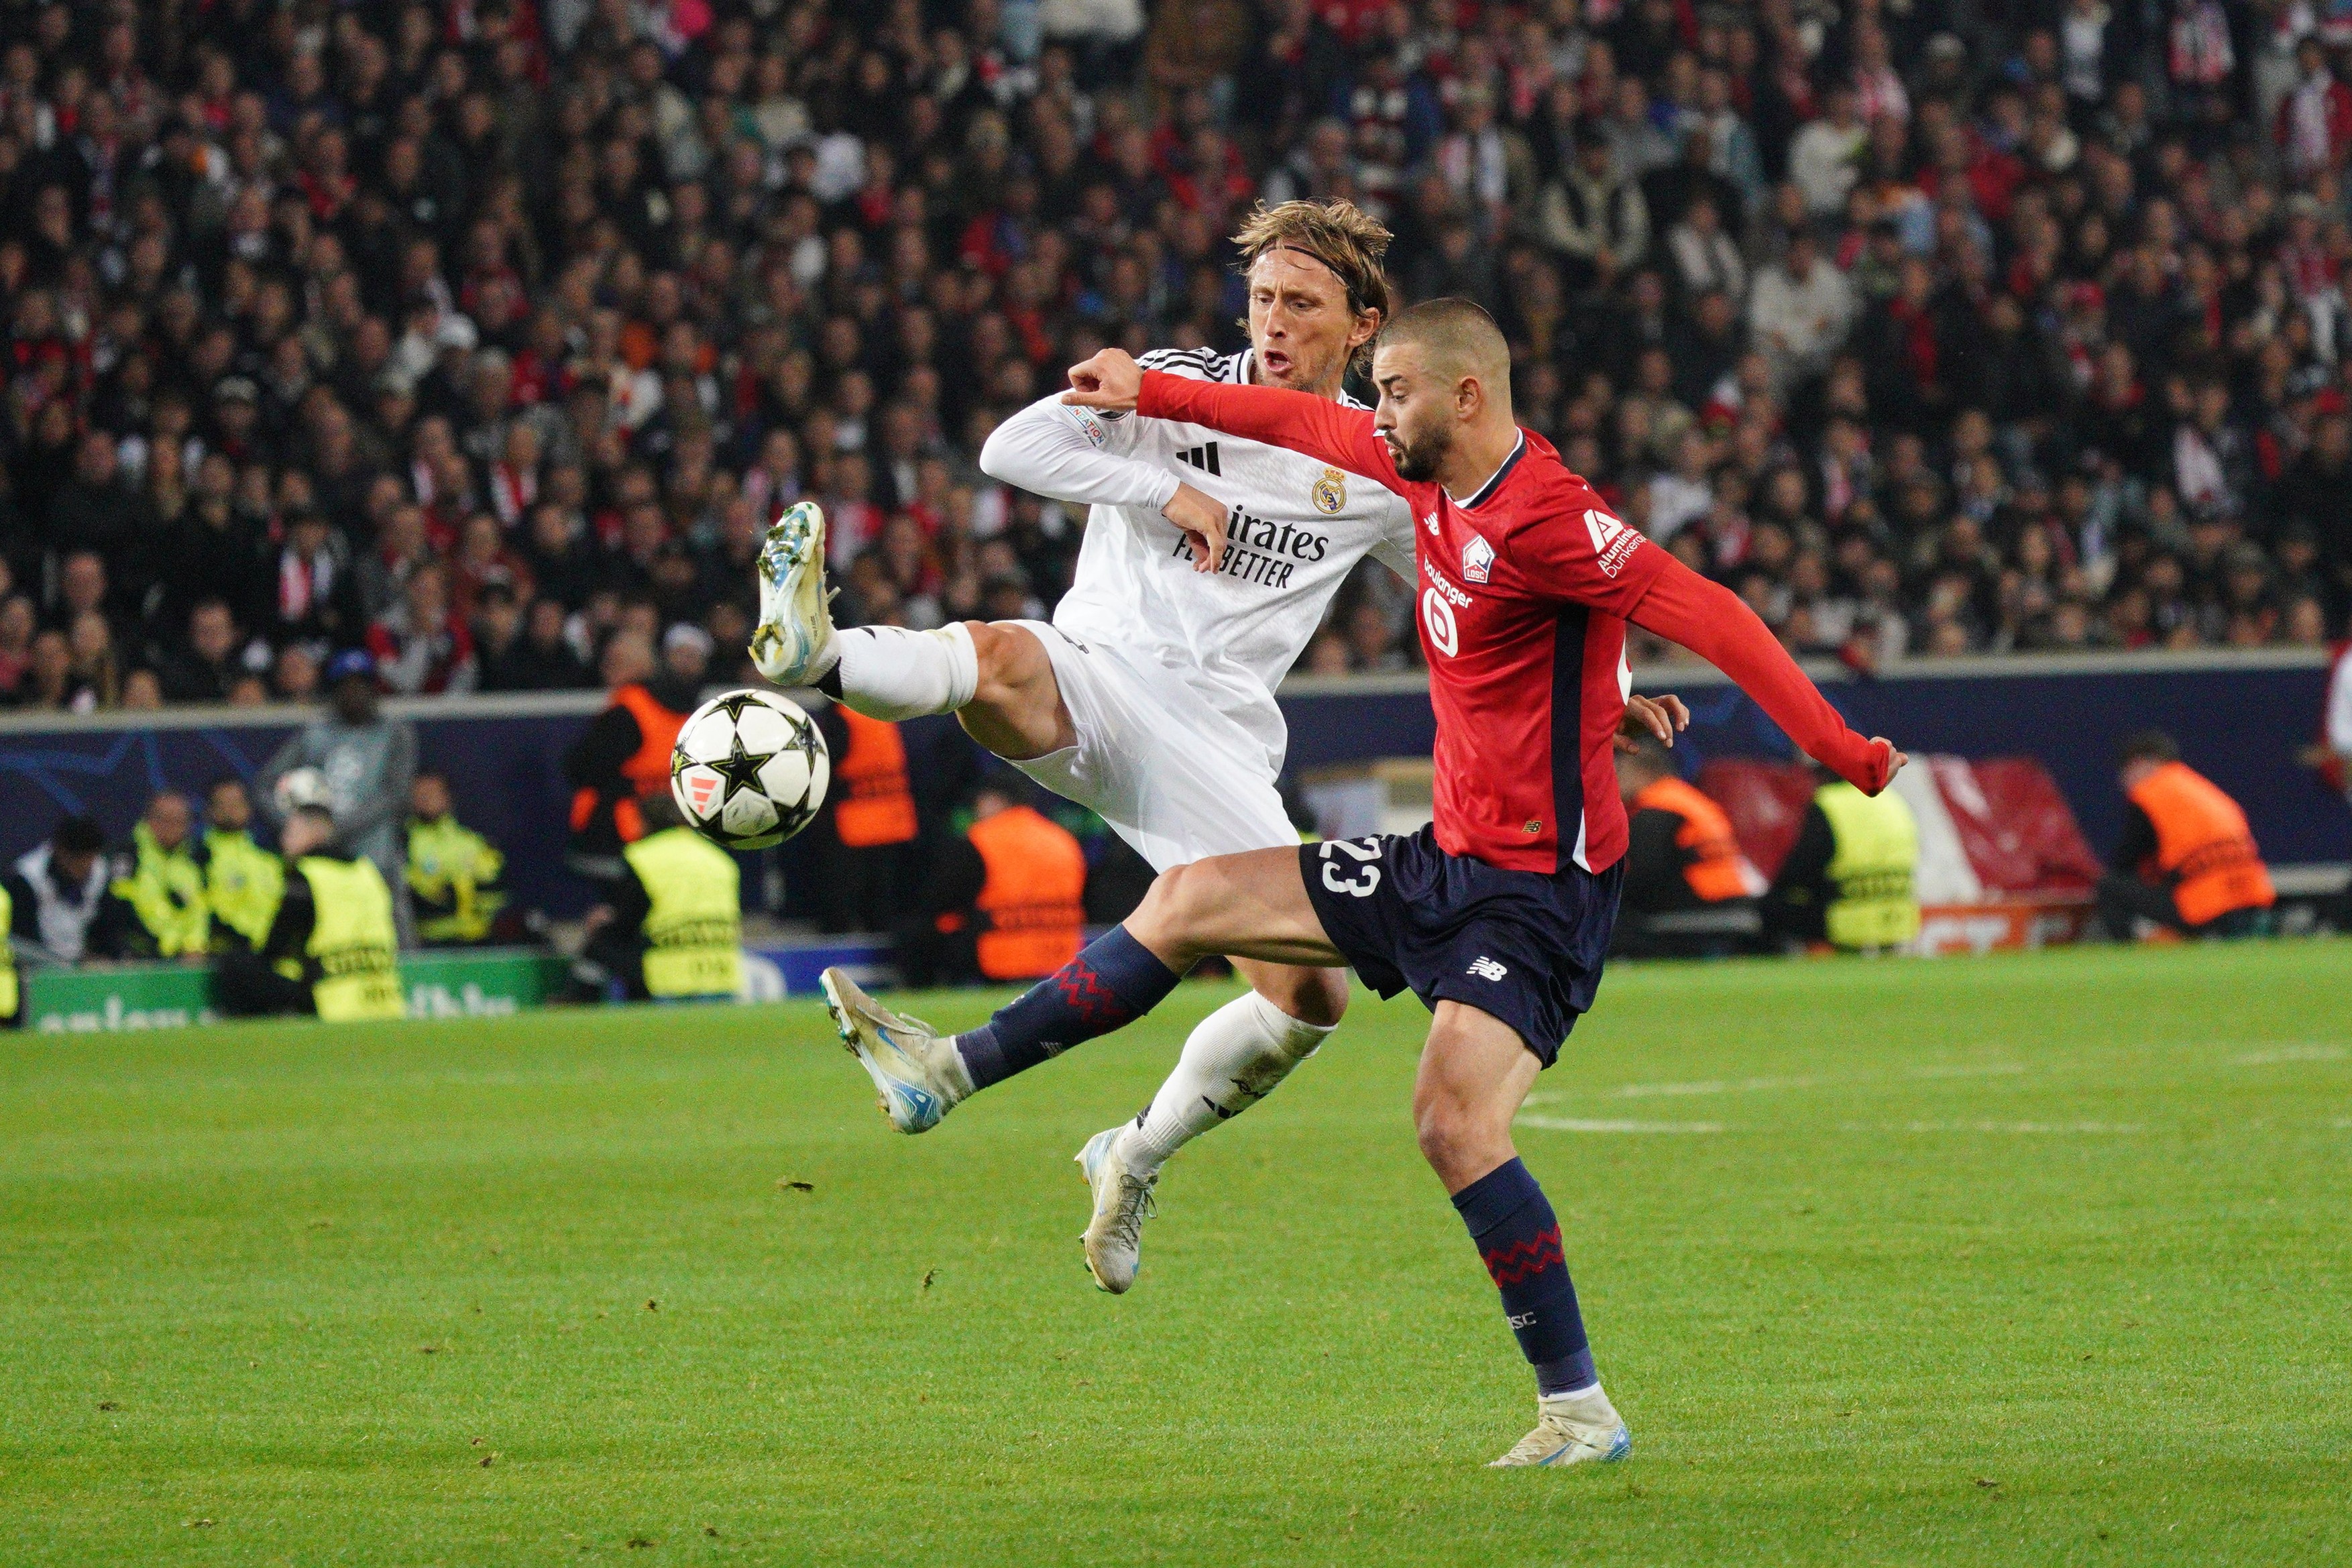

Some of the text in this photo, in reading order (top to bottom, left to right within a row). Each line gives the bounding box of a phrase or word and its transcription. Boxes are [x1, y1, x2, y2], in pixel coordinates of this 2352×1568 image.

[1227, 505, 1329, 561] irates
[1219, 545, 1294, 589] BETTER
[1424, 553, 1473, 608] boulanger
[1467, 569, 1485, 580] LOSC
[1319, 837, 1382, 897] 23
